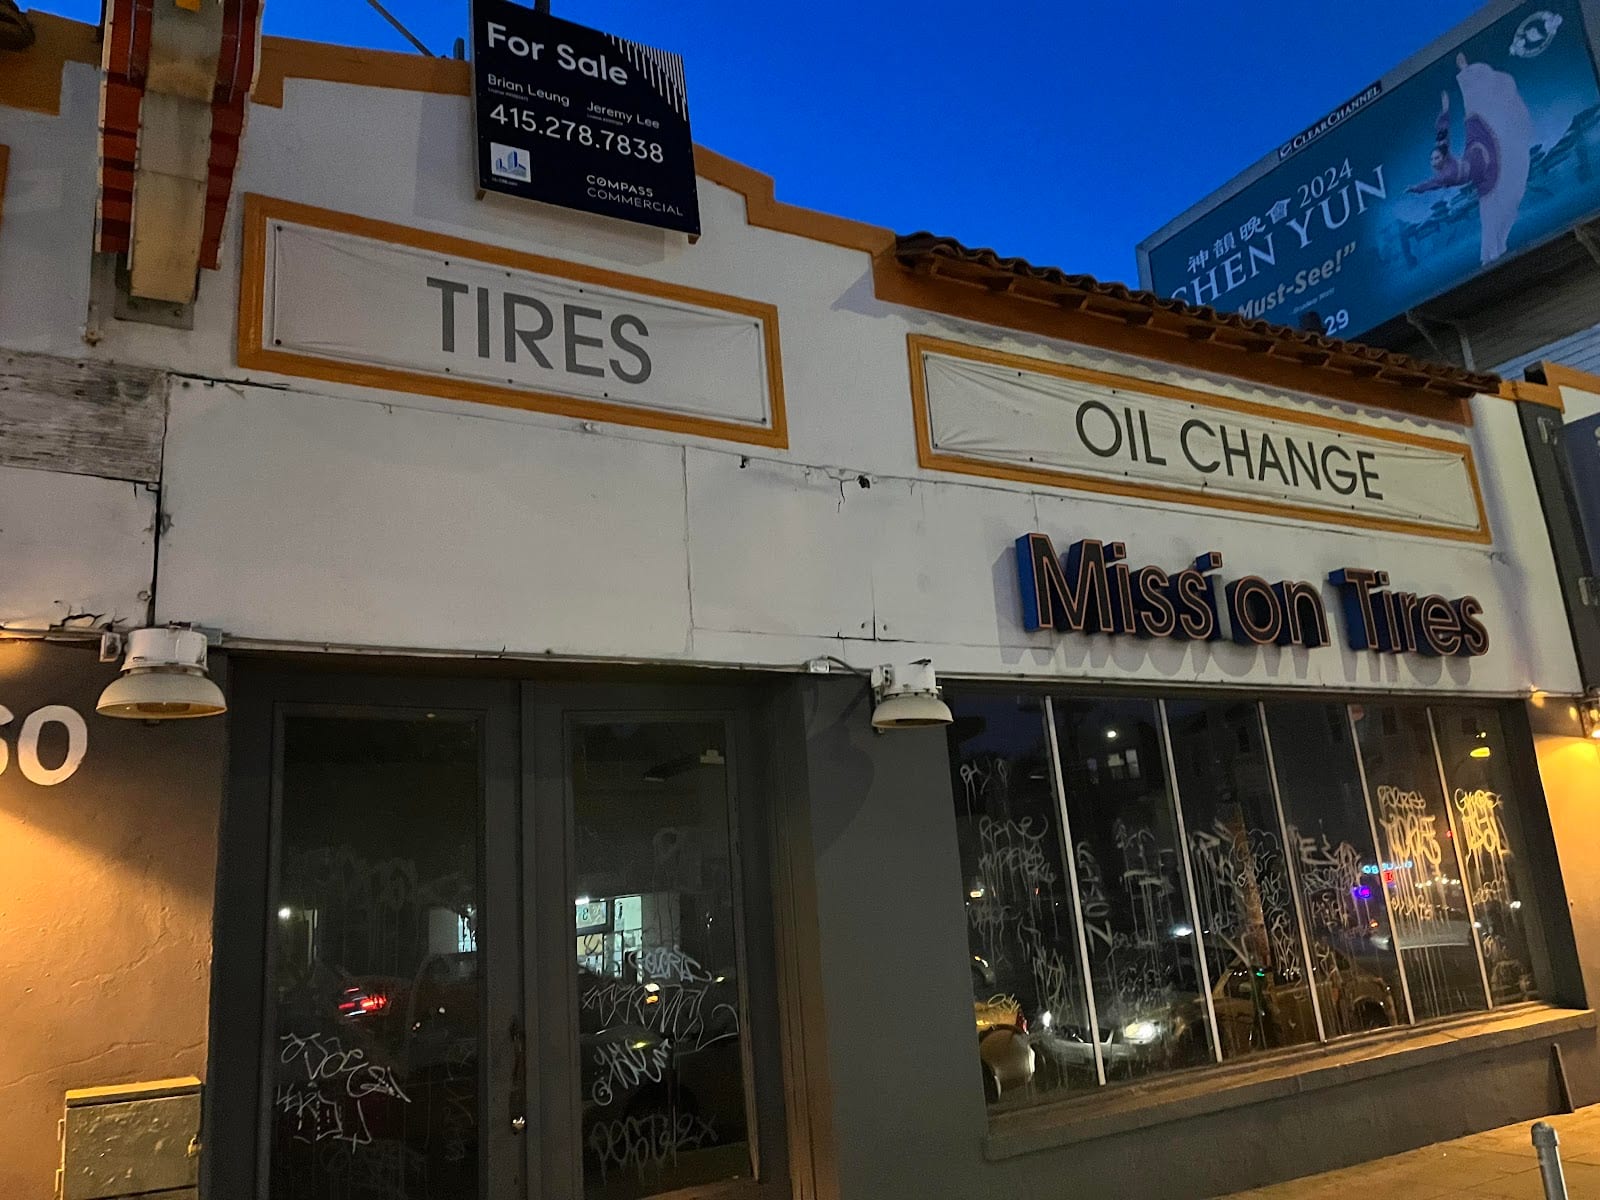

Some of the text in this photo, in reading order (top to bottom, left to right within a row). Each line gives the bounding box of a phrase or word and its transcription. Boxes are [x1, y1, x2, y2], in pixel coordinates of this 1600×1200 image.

[487, 21, 628, 85] For Sale
[487, 73, 523, 93] Brian
[528, 84, 570, 107] Leung
[586, 101, 633, 124] Jeremy
[636, 113, 660, 130] Lee
[490, 104, 664, 164] 415.278.7838
[586, 174, 653, 198] COMPASS
[587, 187, 683, 217] COMMERCIAL
[1286, 164, 1388, 249] YUN
[1297, 158, 1353, 208] 2024
[427, 277, 652, 385] TIRES
[1324, 308, 1350, 337] 29
[1075, 400, 1384, 500] OIL CHANGE
[1015, 533, 1489, 657] Misson Tires
[0, 703, 88, 786] 0
